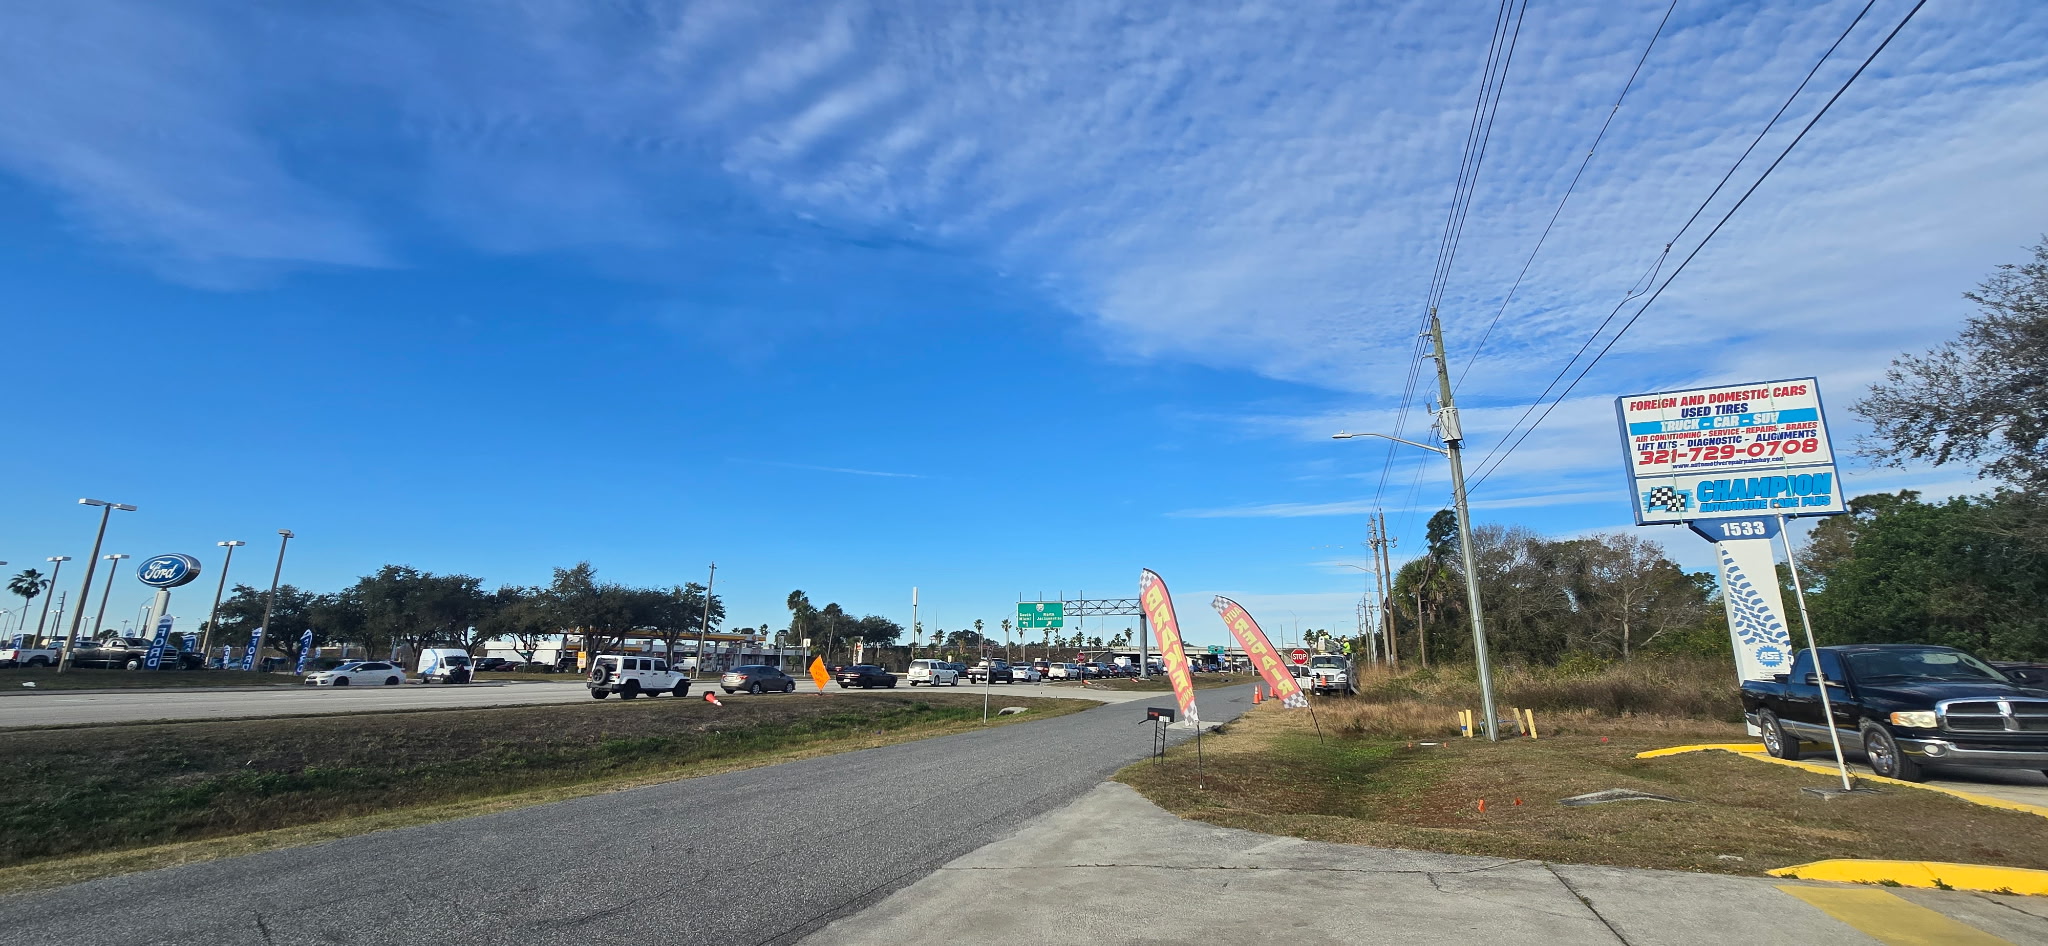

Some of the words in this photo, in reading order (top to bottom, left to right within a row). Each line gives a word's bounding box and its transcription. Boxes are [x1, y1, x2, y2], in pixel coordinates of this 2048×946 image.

[1629, 397, 1677, 412] FOREIGN
[1680, 394, 1705, 407] AND
[1708, 388, 1769, 404] DOMESTIC
[1773, 384, 1807, 398] CARS
[1681, 405, 1711, 418] USED
[1715, 402, 1748, 415] TIRES
[1651, 431, 1701, 441] CONDITIONING
[1708, 428, 1739, 437] SERVICE
[1746, 425, 1778, 434] REPAIRS
[1785, 421, 1818, 430] BRAKES
[1660, 418, 1700, 432] TRUCK
[1713, 415, 1739, 428] CAR
[1752, 411, 1780, 424] SUV
[1637, 442, 1655, 451] LIFT
[1657, 440, 1678, 450] KITS
[1687, 435, 1742, 447] DIAGNOSTIC
[1755, 429, 1817, 442] ALIGNMENTS
[1638, 438, 1819, 466] 321-729-0708
[1696, 472, 1833, 503] CHAMPION
[1698, 499, 1768, 513] AUTOMOTIVE
[1770, 497, 1799, 509] CARE
[1801, 495, 1831, 508] PLUS
[1720, 521, 1766, 537] 1533
[144, 560, 179, 580] Ford
[1759, 651, 1780, 660] ASE
